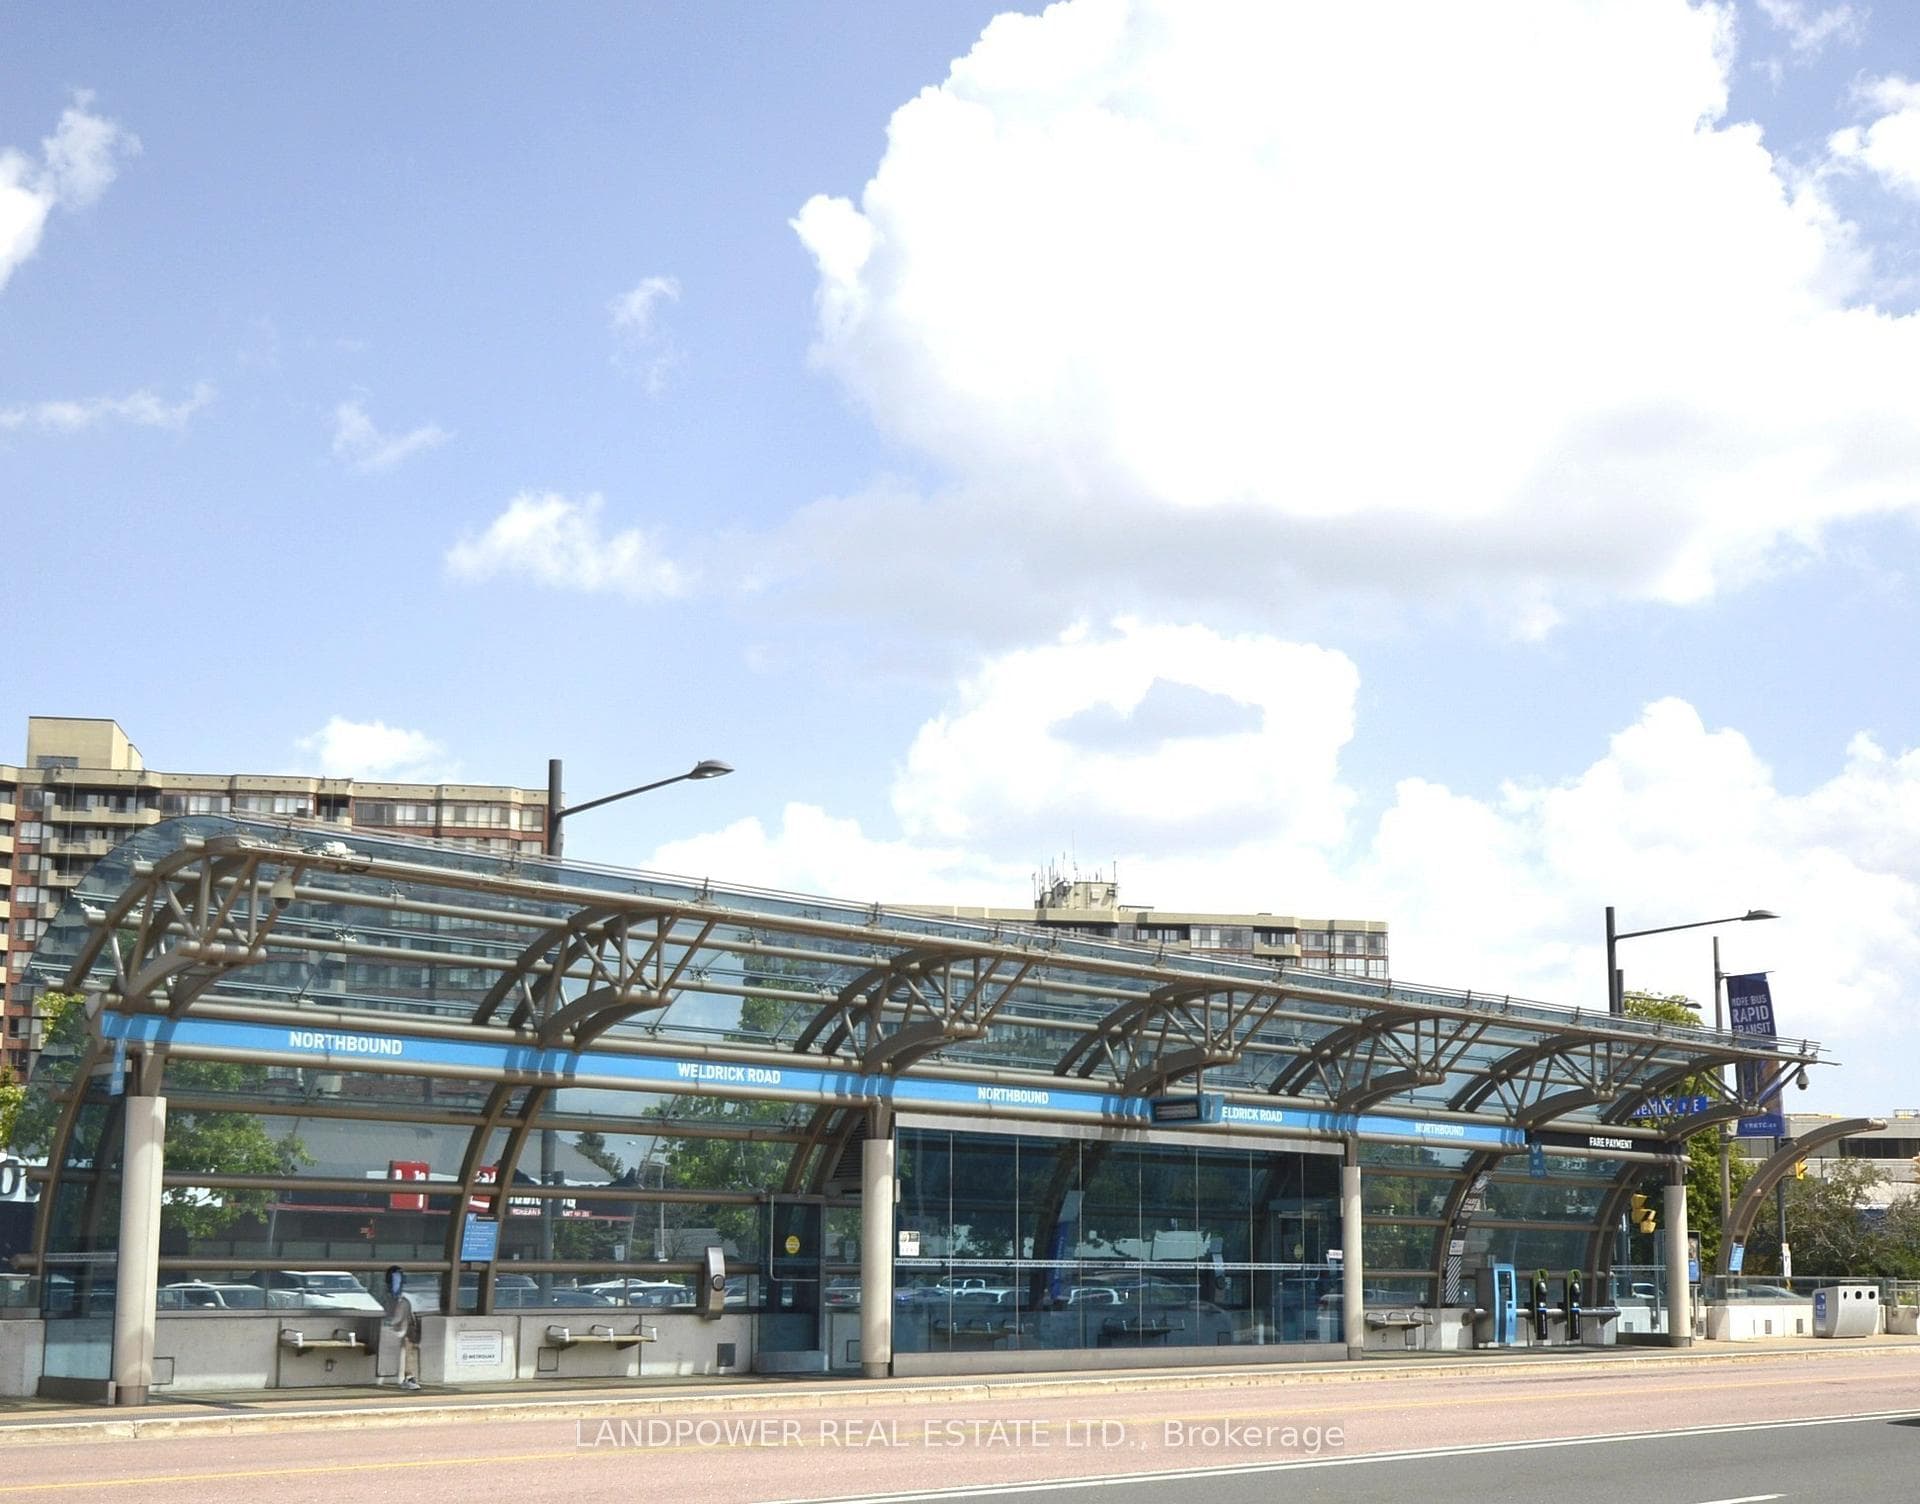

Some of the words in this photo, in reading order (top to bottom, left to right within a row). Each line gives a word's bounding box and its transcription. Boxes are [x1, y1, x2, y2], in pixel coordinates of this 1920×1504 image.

[1751, 994, 1767, 1005] BUS
[1732, 1005, 1769, 1023] RAPID
[1733, 1021, 1771, 1035] TRANSIT
[289, 1031, 403, 1055] NORTHBOUND
[678, 1062, 745, 1082] WELDRICK
[748, 1068, 781, 1084] ROAD
[977, 1086, 1049, 1105] NORTHBOUND
[1221, 1106, 1259, 1121] ELDRICK
[1260, 1109, 1283, 1122] ROAD
[1415, 1122, 1465, 1137] NORTHBOUND
[1589, 1136, 1605, 1147] FARE
[1605, 1138, 1633, 1150] PAYMENT
